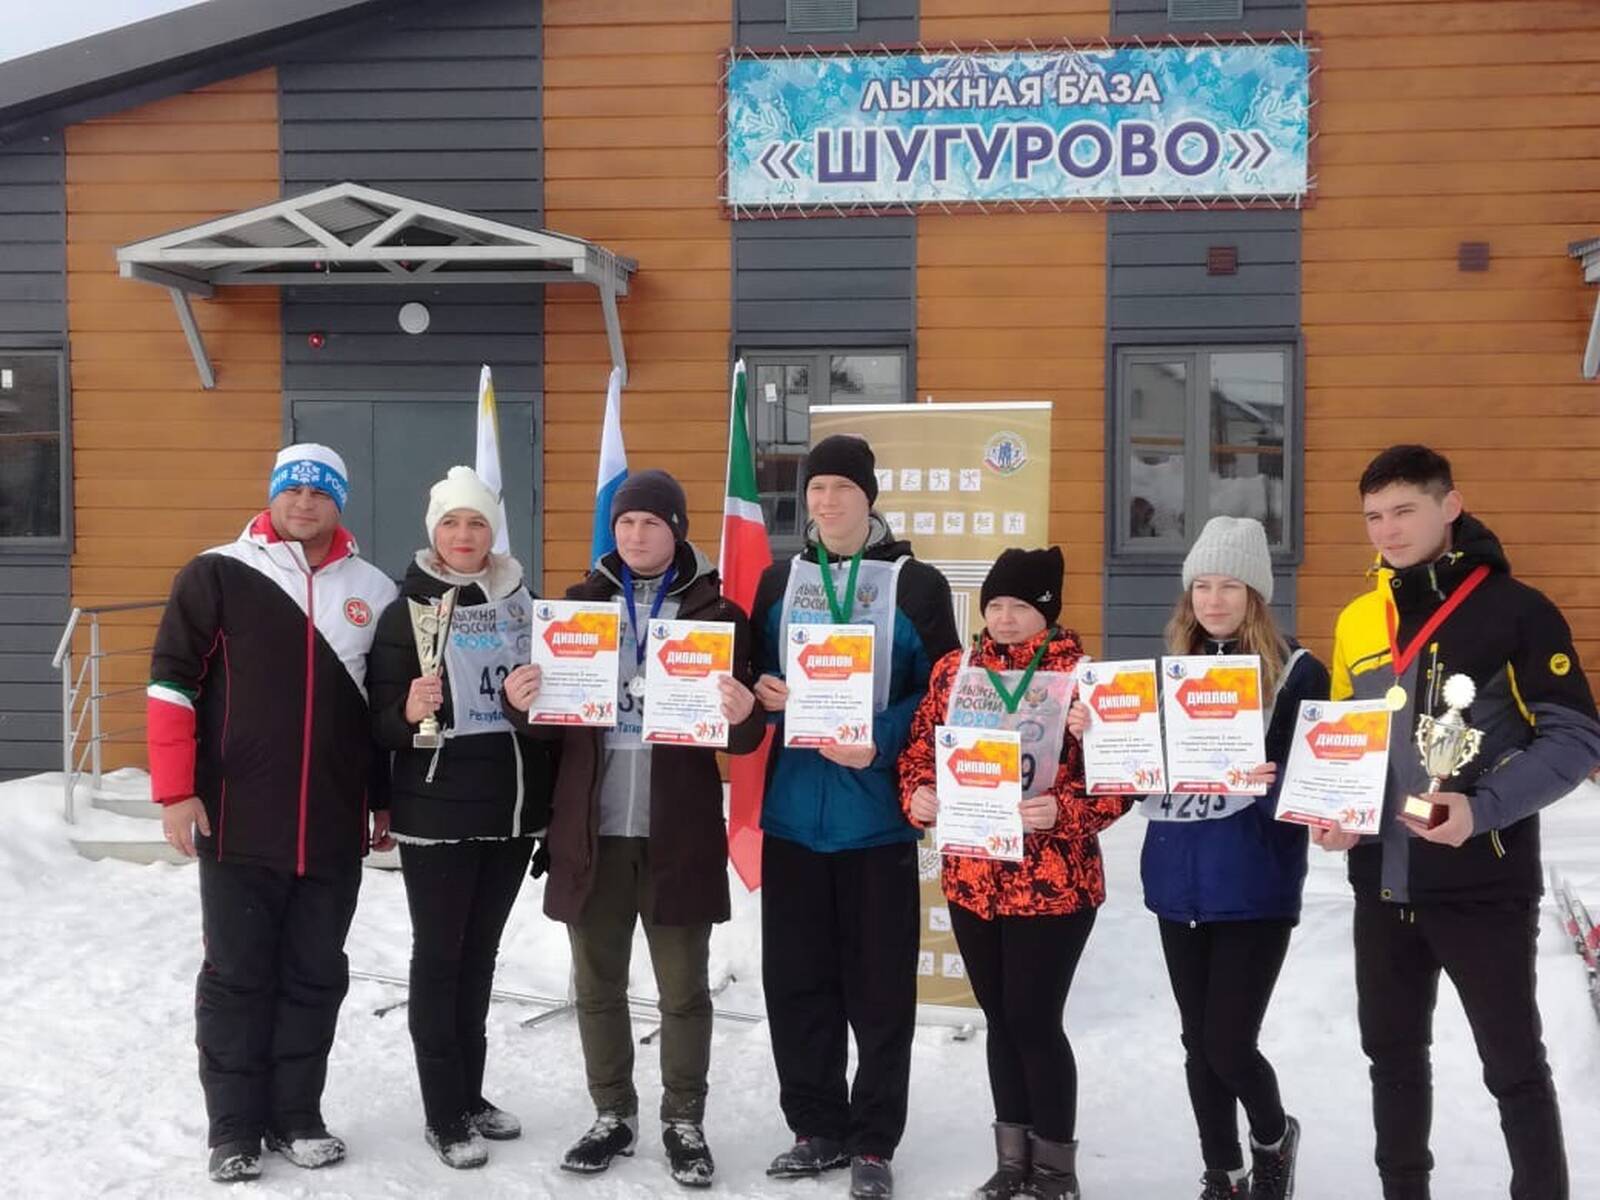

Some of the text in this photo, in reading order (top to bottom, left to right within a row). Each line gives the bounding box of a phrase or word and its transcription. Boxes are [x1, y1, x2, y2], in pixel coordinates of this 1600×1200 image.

[862, 73, 1162, 111] ЛЫЖНАЯ БАЗА
[760, 121, 1272, 183] «ШУГУРОВО»
[552, 631, 600, 646] ДИПЛОМ
[666, 650, 712, 665] ДИПЛОМ
[806, 654, 853, 670] ДИПЛОМ
[1098, 694, 1141, 710] ДИПЛОМ
[1187, 691, 1238, 706] ДИПЛОМ
[1315, 733, 1367, 748] ДИПЛОМ
[956, 759, 1002, 776] ДИПЛОМ
